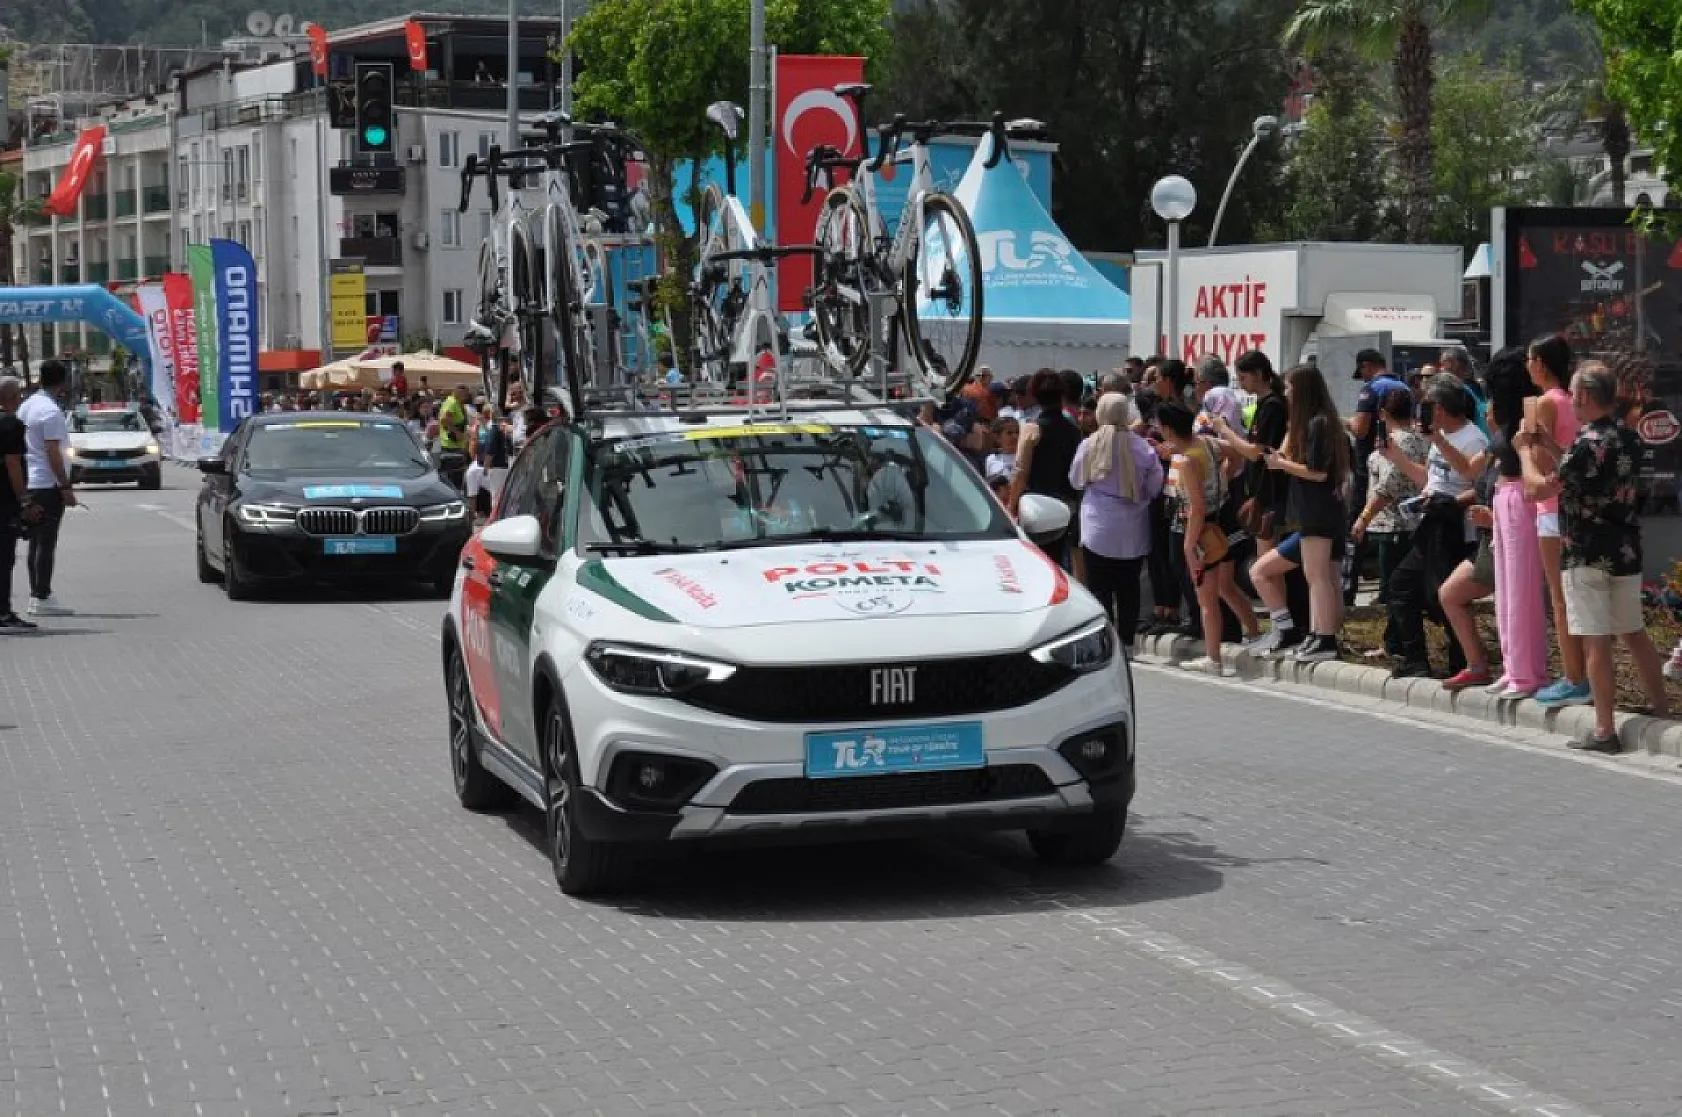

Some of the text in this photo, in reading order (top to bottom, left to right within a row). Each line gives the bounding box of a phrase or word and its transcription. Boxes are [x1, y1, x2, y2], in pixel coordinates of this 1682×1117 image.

[1194, 275, 1267, 318] AKTİF
[762, 561, 942, 583] POLTI
[785, 575, 939, 592] KOMETA
[870, 666, 917, 705] FIAT
